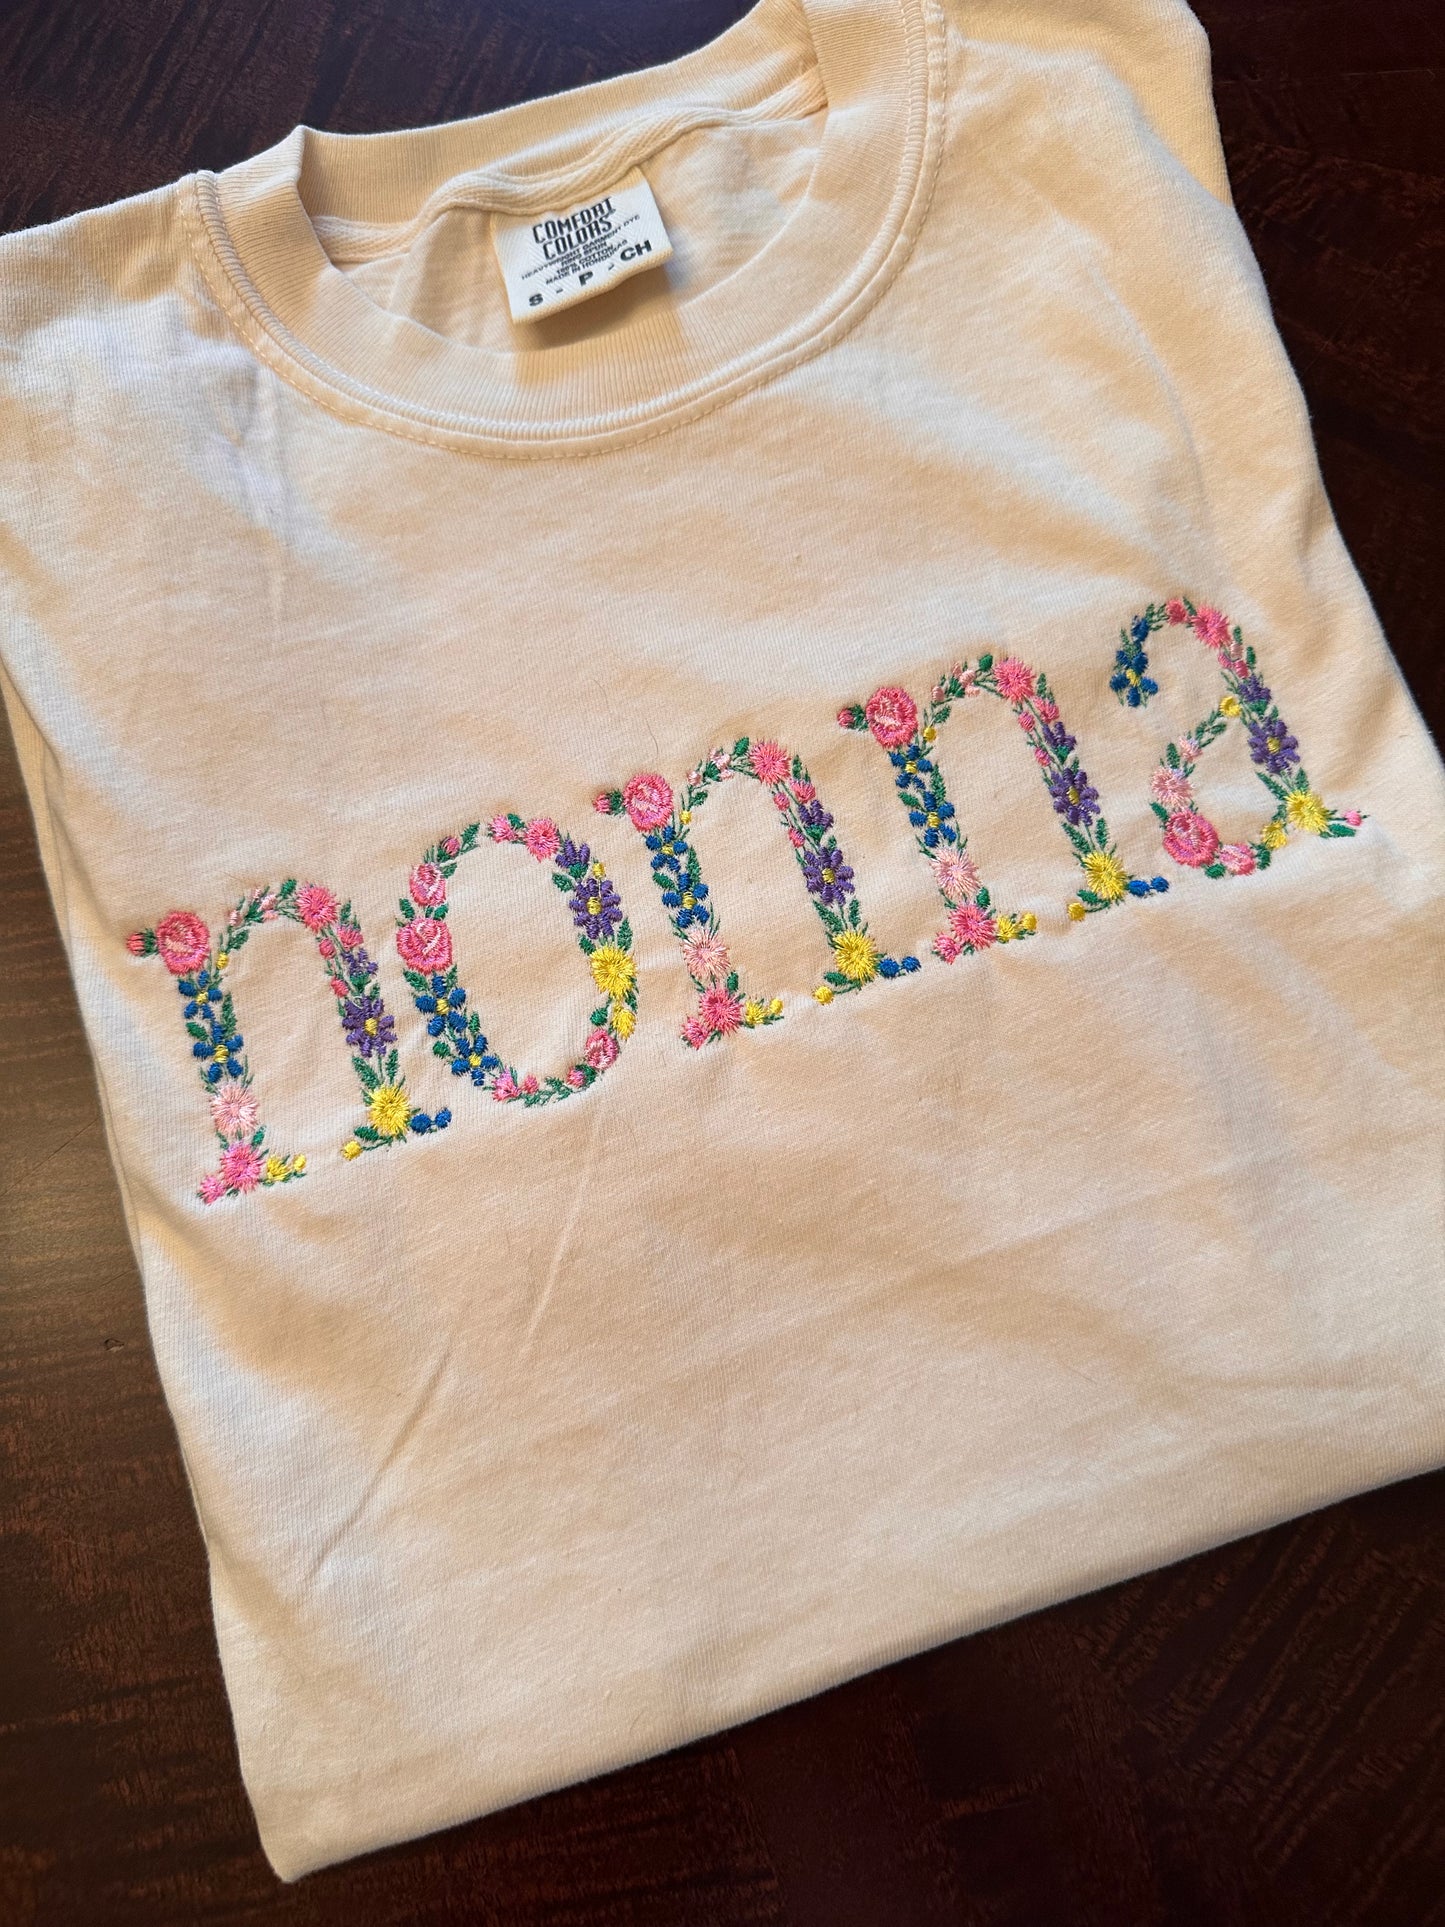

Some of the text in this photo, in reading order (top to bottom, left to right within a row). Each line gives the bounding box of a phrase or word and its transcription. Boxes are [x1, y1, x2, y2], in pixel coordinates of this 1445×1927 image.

[533, 197, 616, 244] COMFORT
[543, 215, 612, 260] COLORS
[529, 294, 543, 307] S
[579, 271, 593, 286] P
[620, 240, 652, 261] CH
[126, 598, 1367, 1204] nonna
